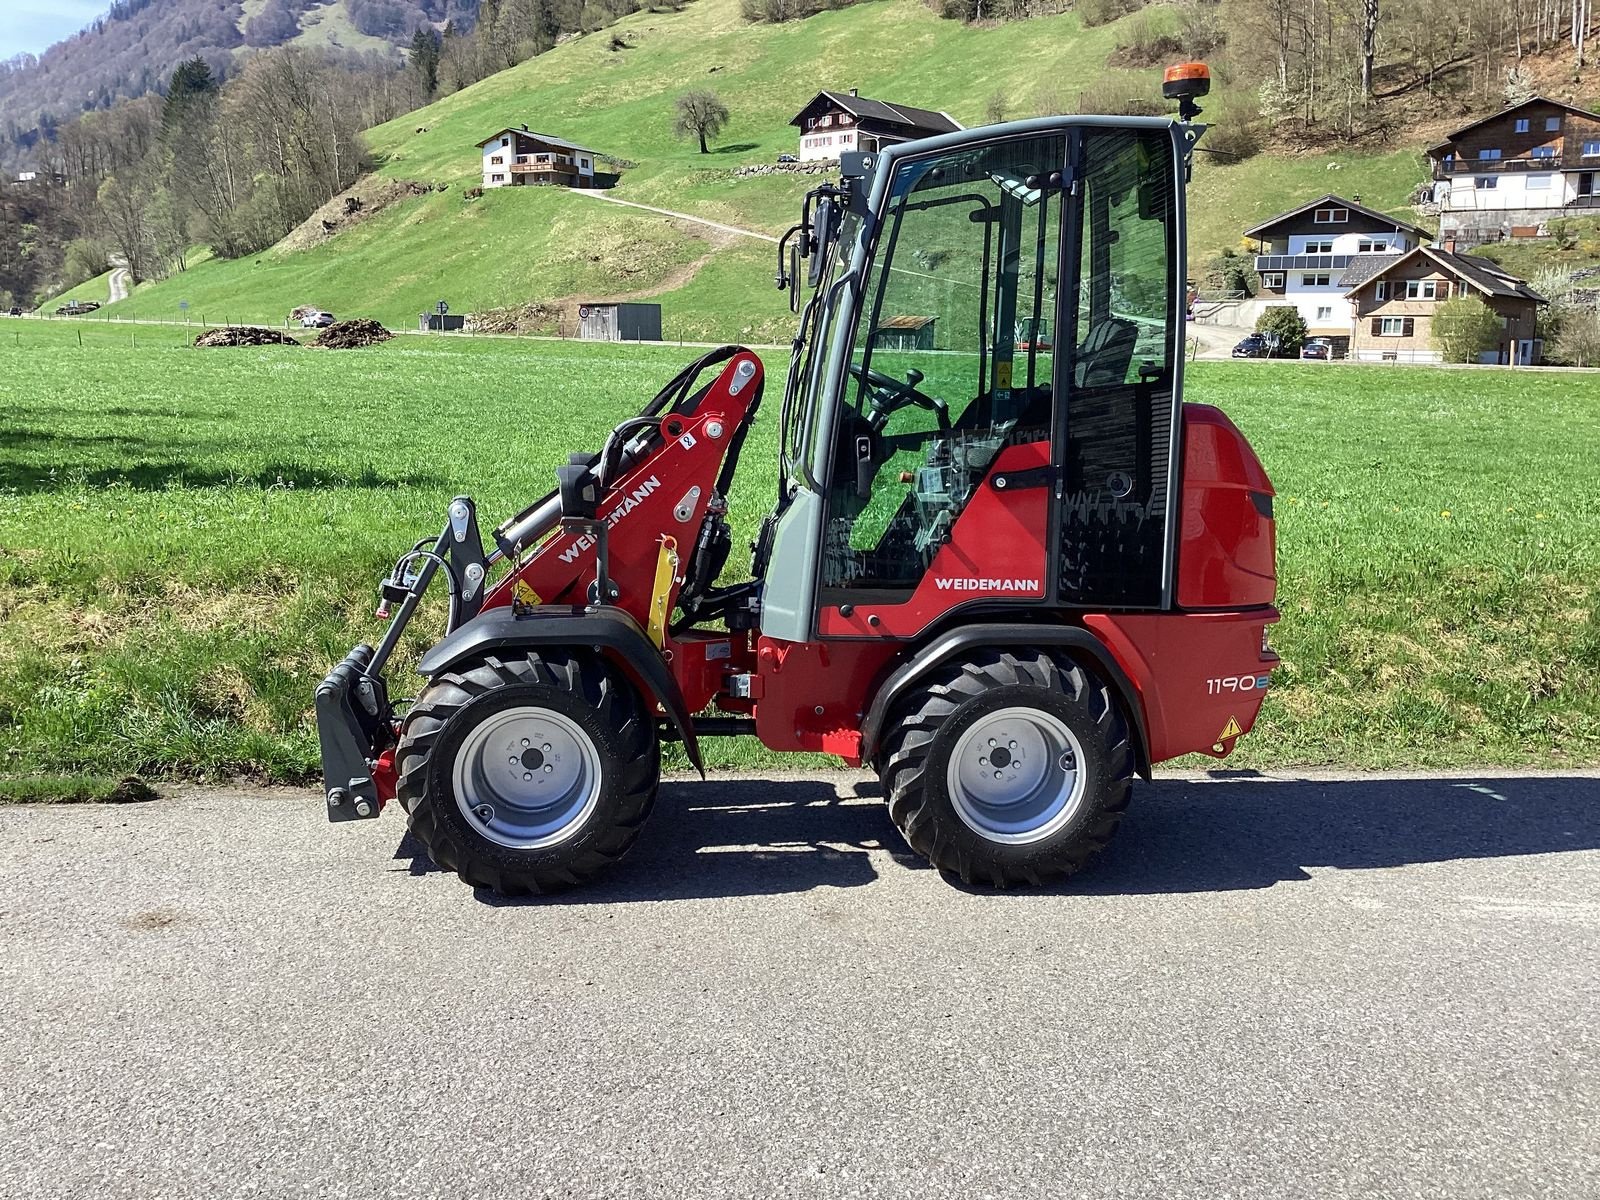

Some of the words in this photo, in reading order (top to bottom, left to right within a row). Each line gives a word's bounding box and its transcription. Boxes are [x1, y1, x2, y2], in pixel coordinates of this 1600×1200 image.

[558, 475, 661, 563] WEIEMANN
[935, 578, 1039, 591] WEIDEMANN
[1207, 675, 1269, 694] 1190e
